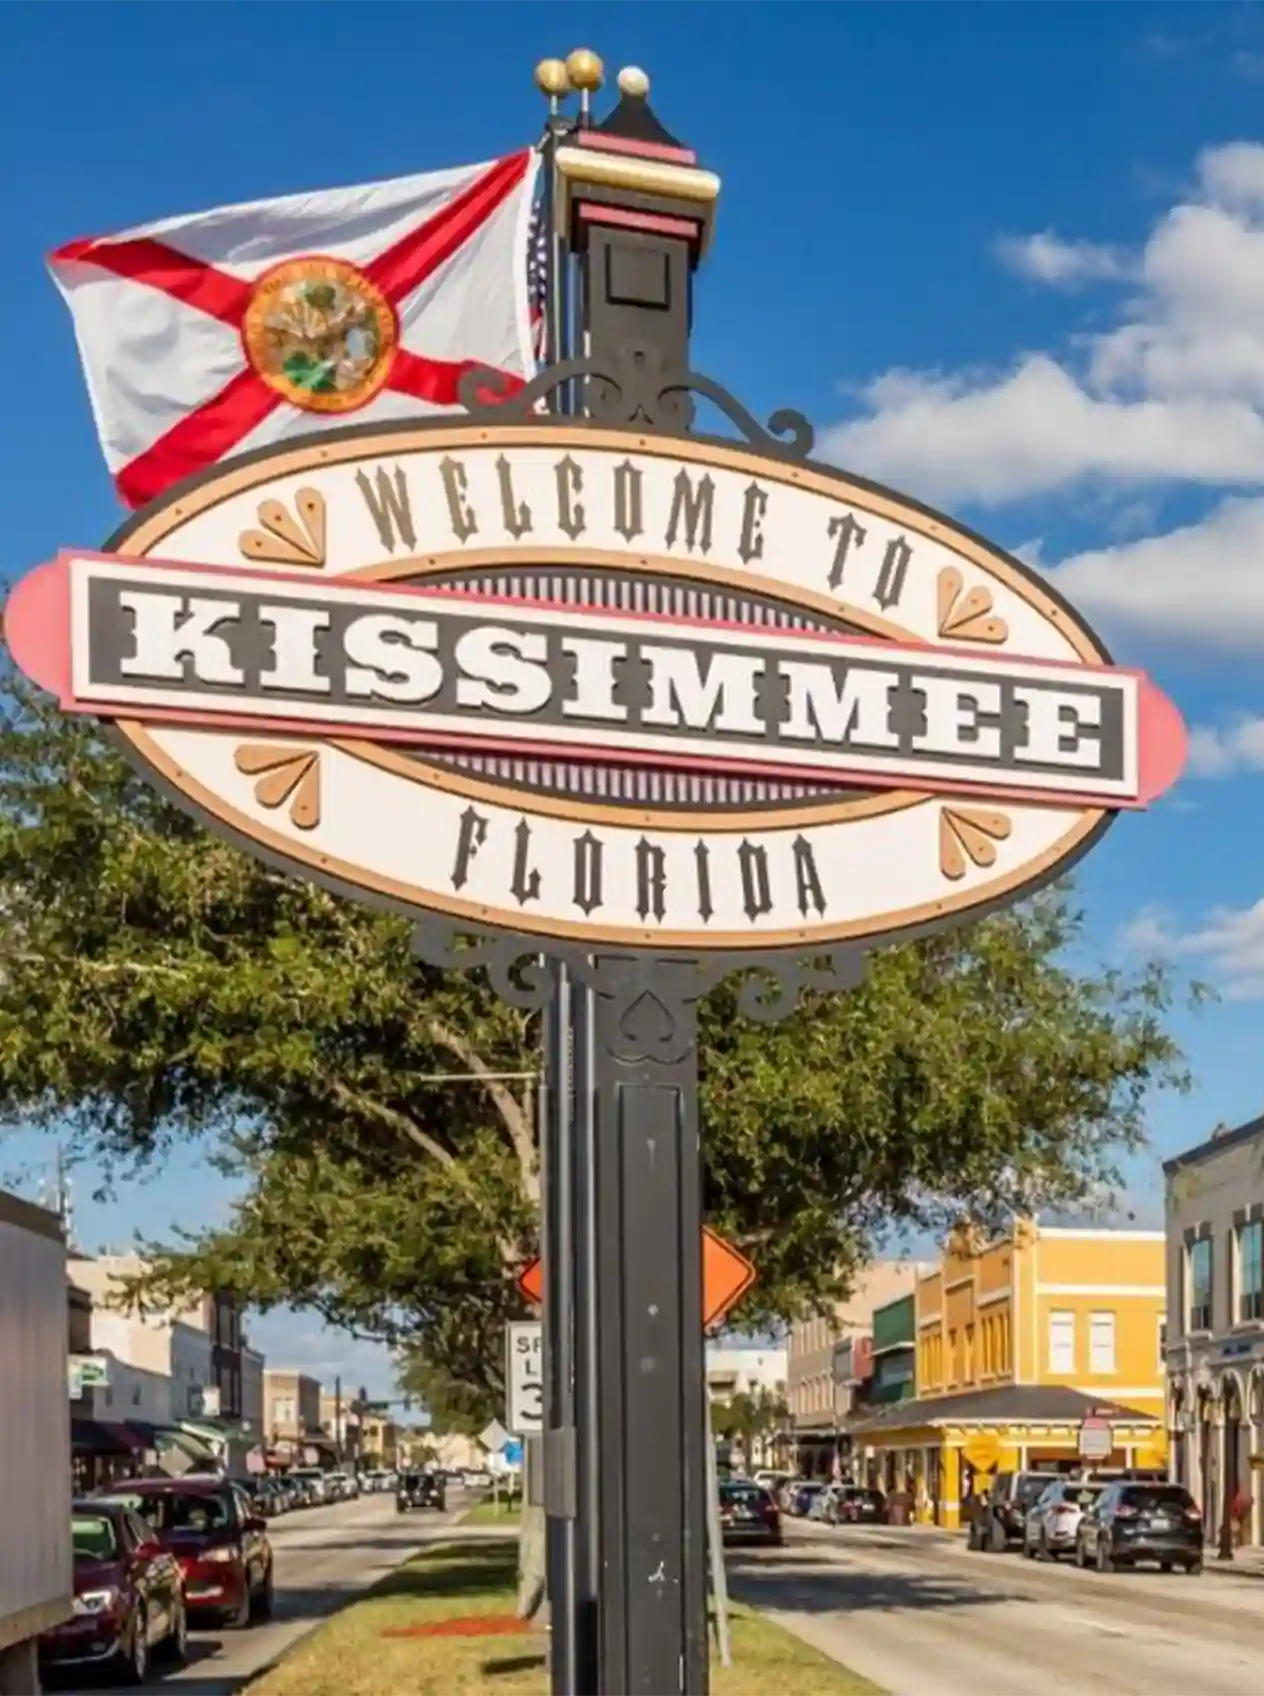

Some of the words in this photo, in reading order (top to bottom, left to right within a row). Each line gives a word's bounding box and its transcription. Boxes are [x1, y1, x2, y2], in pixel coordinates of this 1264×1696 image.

[355, 453, 769, 564] WELCOME
[827, 511, 914, 613] TO
[120, 591, 1101, 769] KISSIMMEE
[450, 805, 828, 924] FLORIDA
